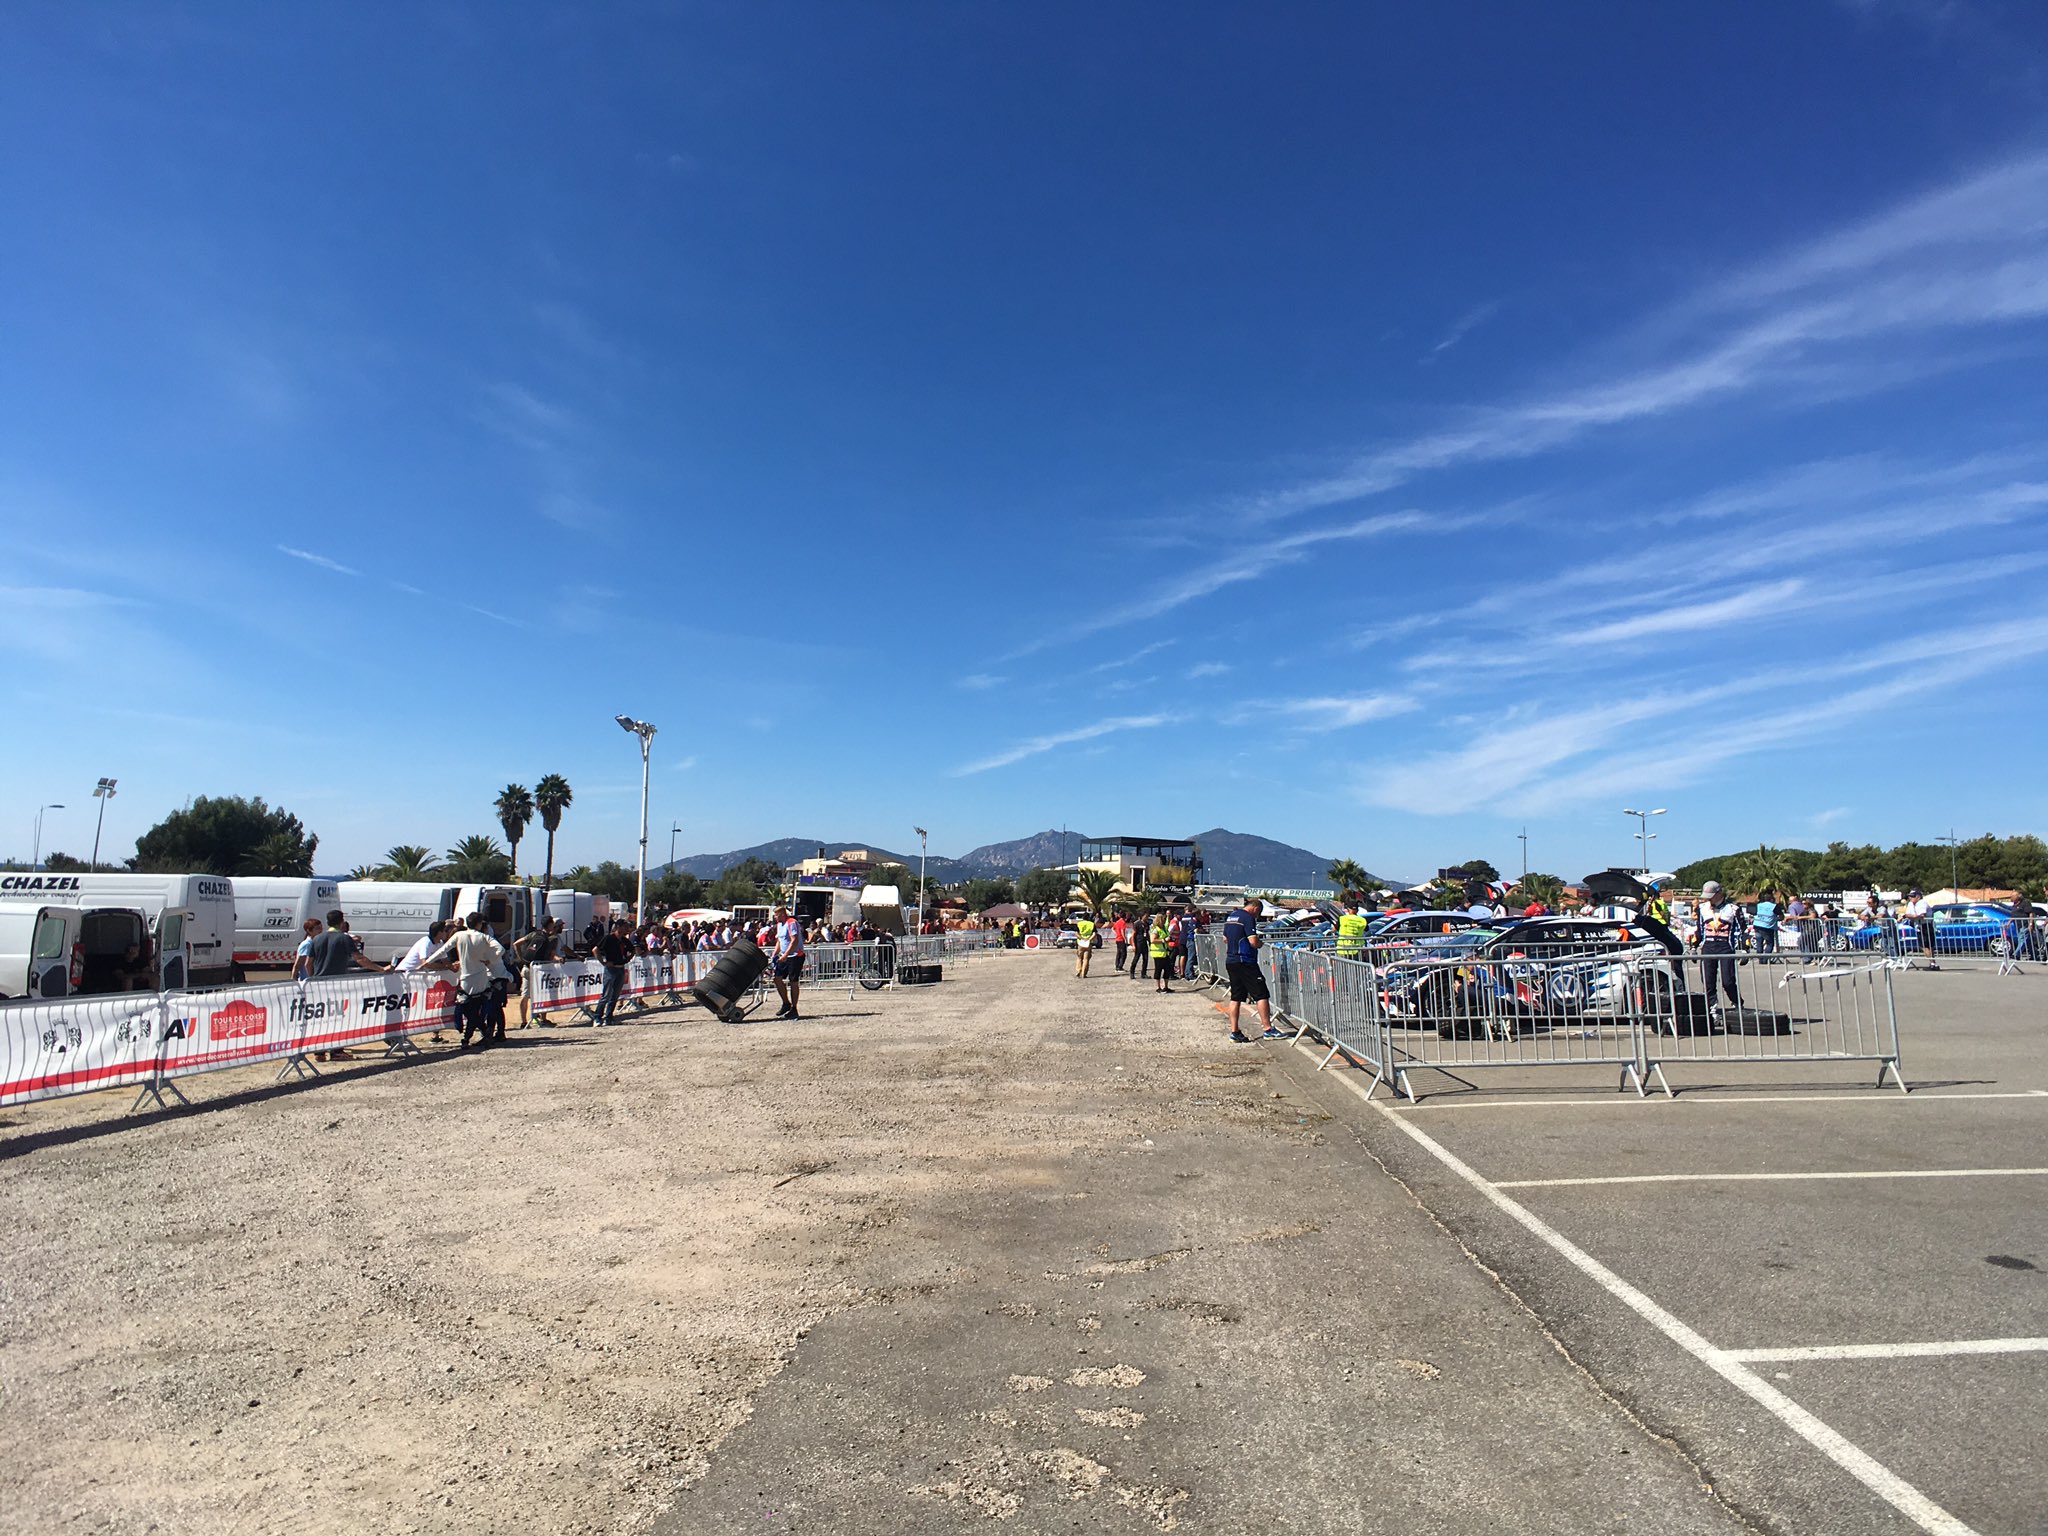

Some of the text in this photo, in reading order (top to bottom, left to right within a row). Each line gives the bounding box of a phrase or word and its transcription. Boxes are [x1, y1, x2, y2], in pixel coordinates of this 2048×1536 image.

[1, 877, 80, 890] CHAZEL
[198, 881, 231, 896] CHAZEL
[577, 973, 602, 988] FFSA
[361, 992, 412, 1014] FFSA
